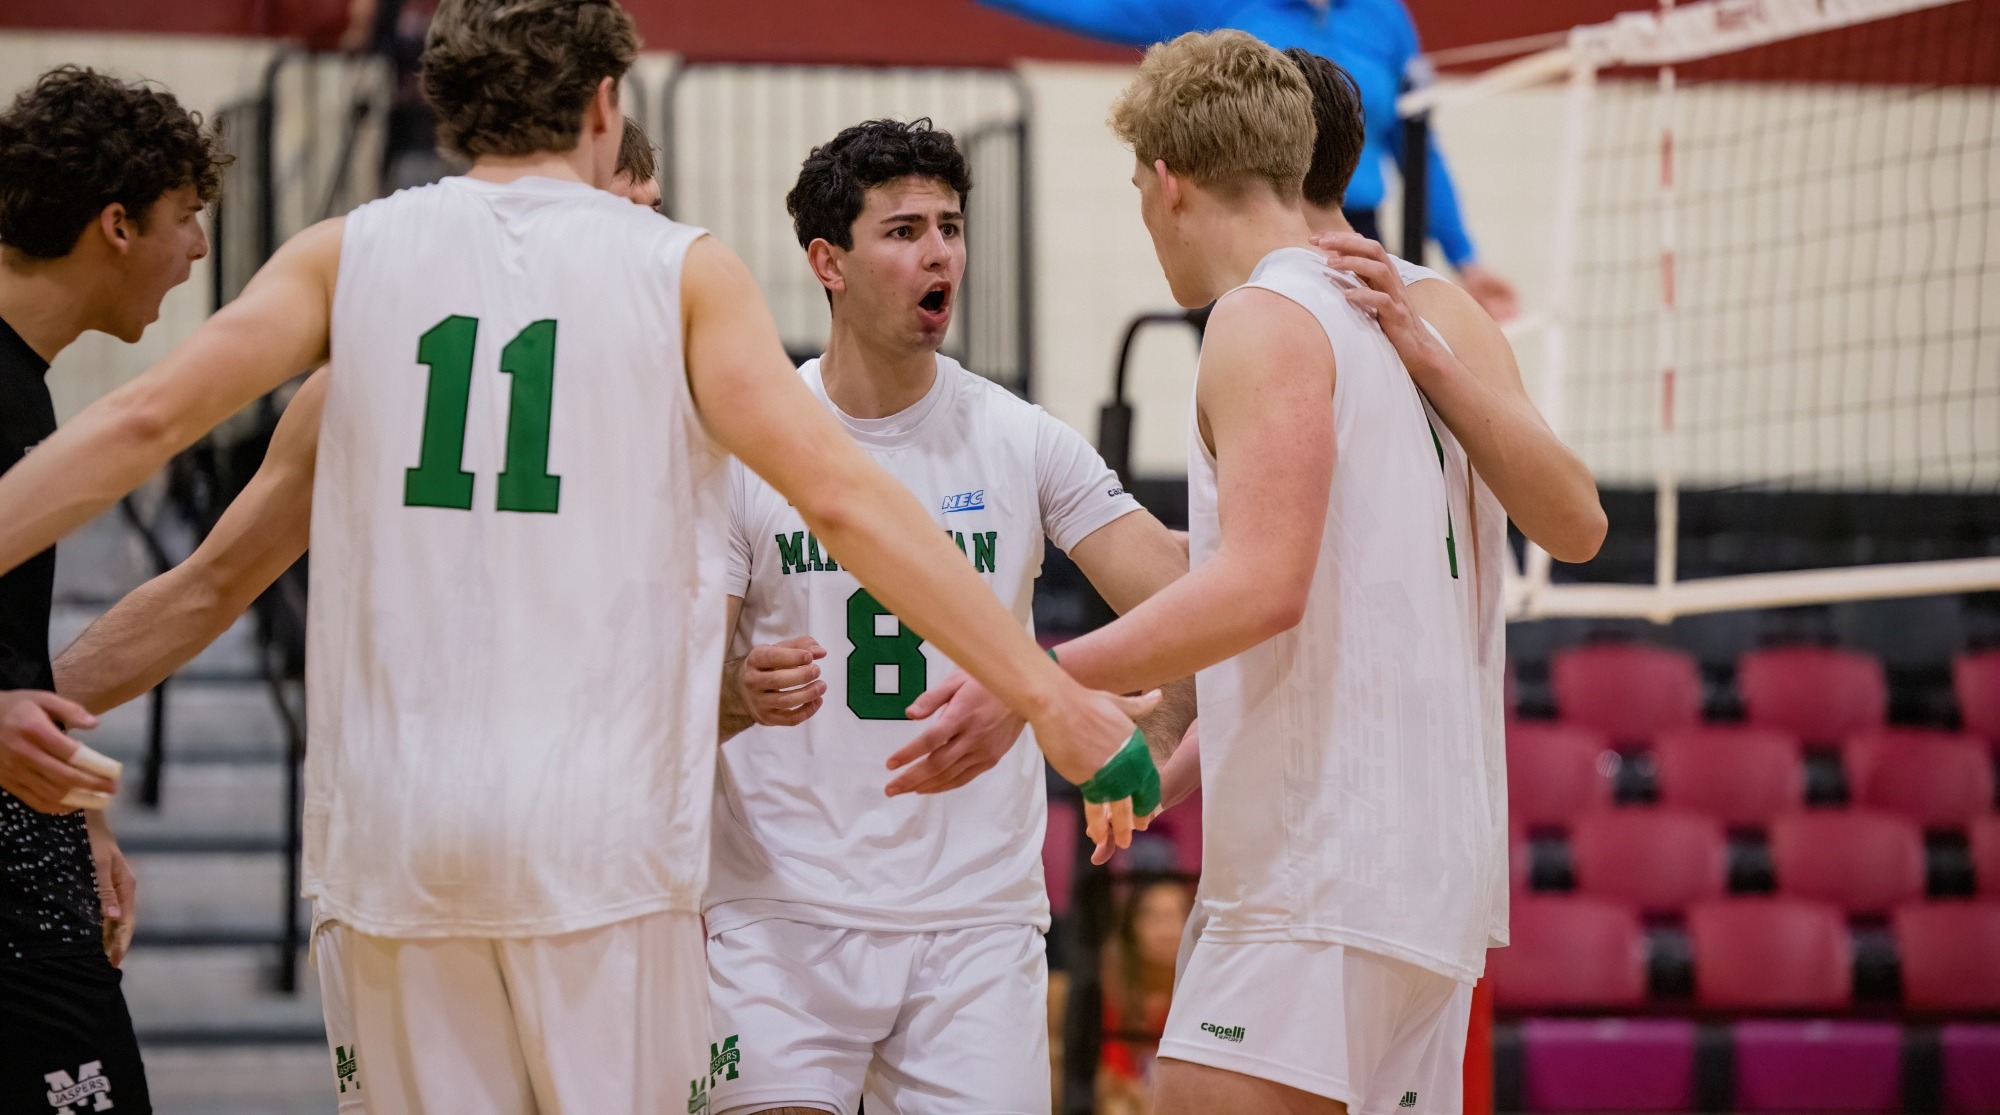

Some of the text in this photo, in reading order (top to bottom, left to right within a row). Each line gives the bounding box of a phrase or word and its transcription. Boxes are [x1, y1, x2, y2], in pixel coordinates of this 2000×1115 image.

[404, 314, 561, 513] 11
[942, 490, 984, 509] NEC
[847, 587, 926, 719] 8
[1201, 1022, 1246, 1039] capelli
[44, 1060, 114, 1115] M
[54, 1079, 104, 1104] JASPERS
